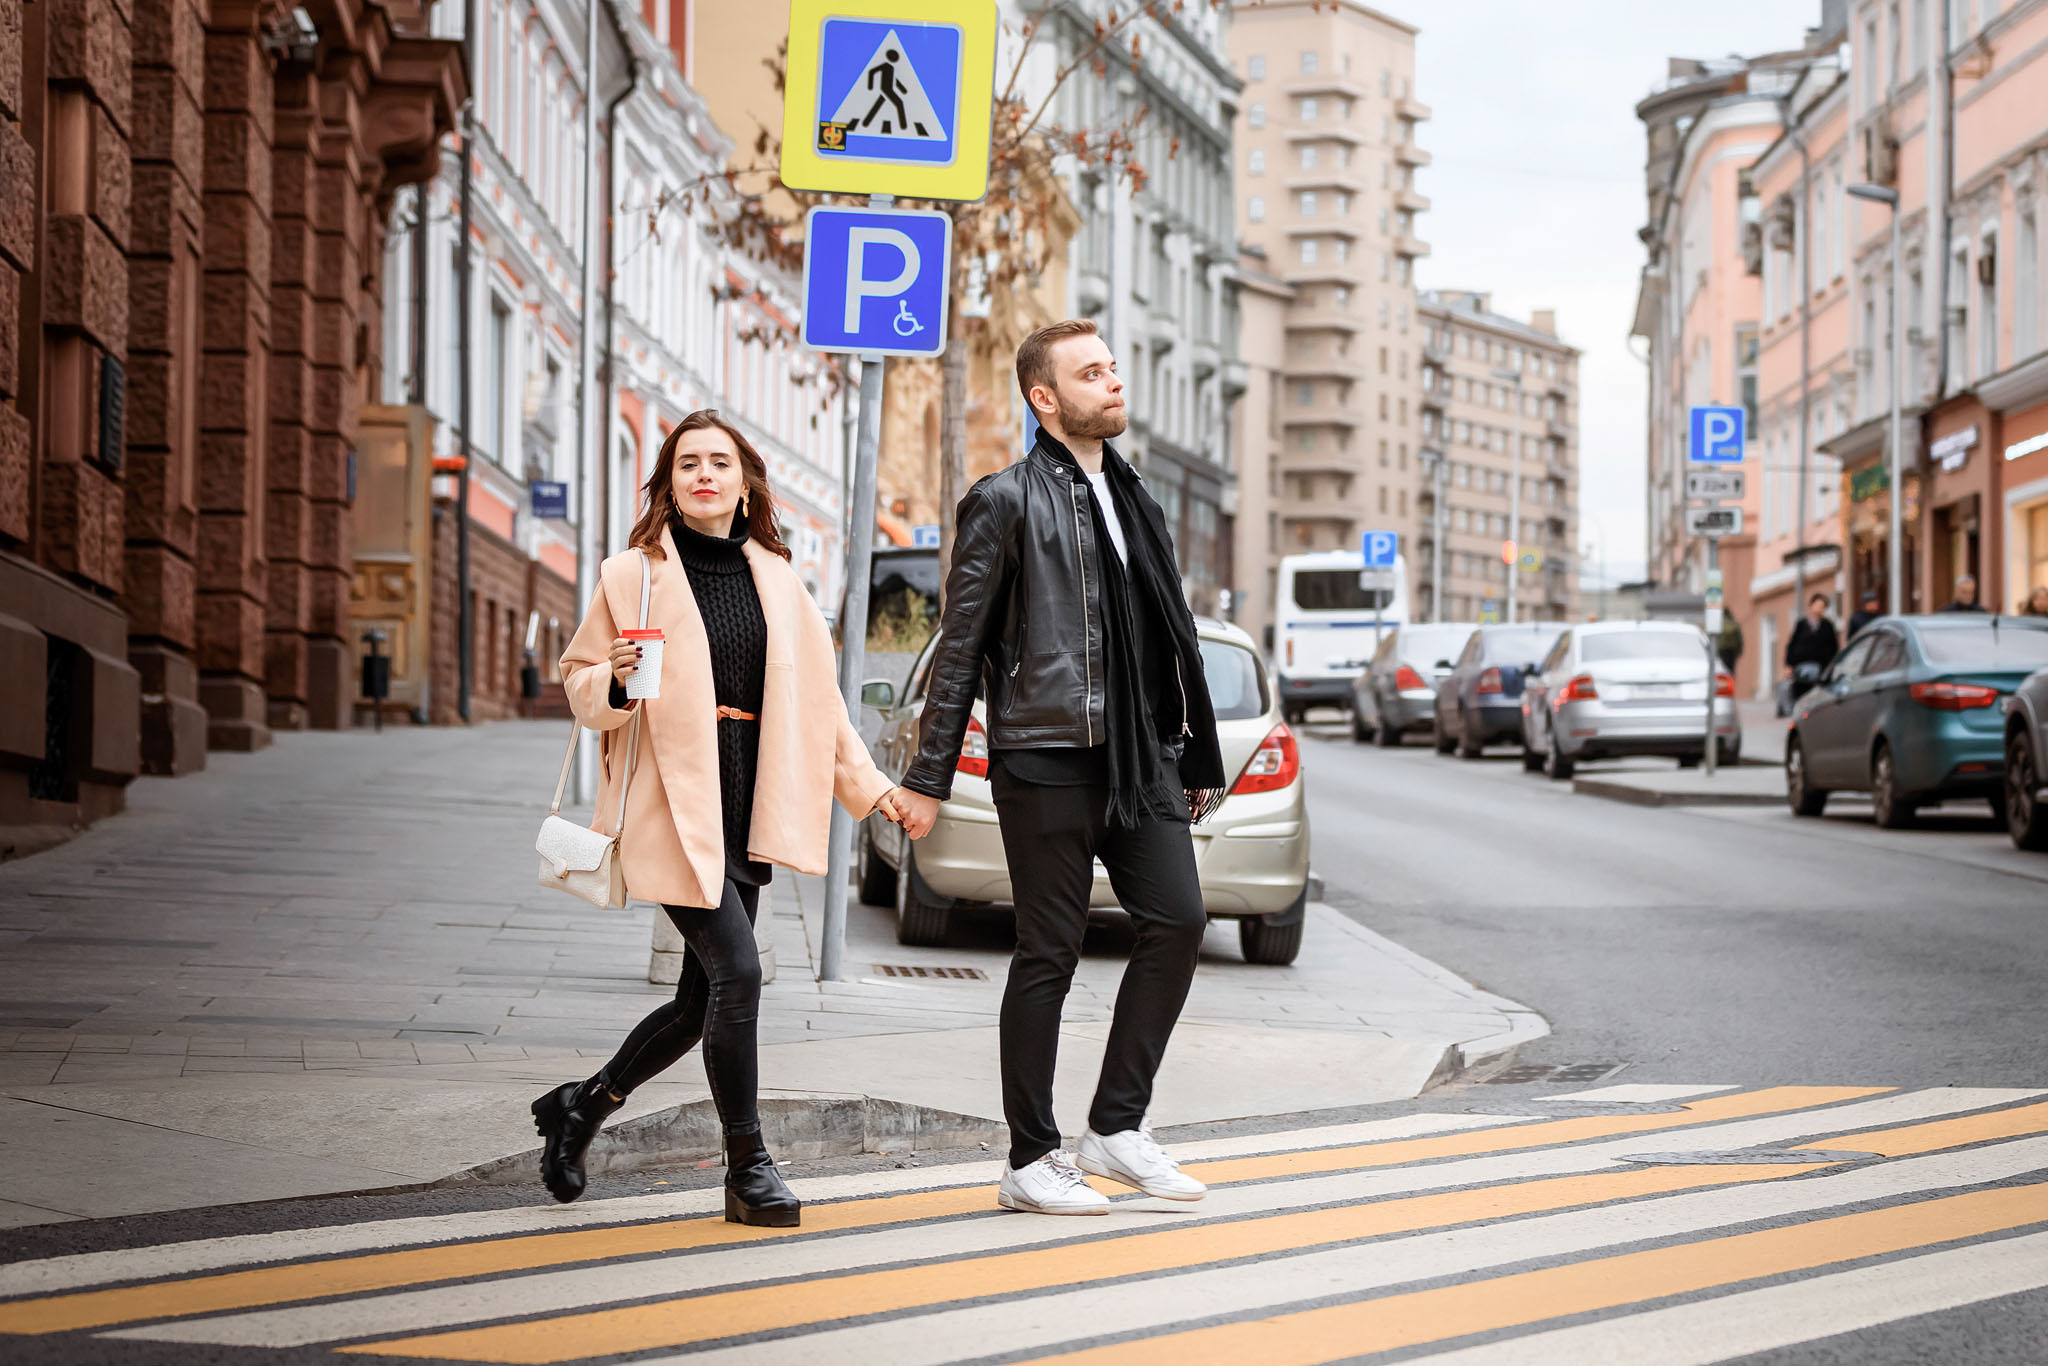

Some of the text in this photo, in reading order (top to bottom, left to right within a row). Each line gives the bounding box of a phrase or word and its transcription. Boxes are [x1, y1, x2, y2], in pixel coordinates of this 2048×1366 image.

[844, 226, 921, 334] P
[1703, 412, 1736, 457] P
[1371, 535, 1391, 563] P
